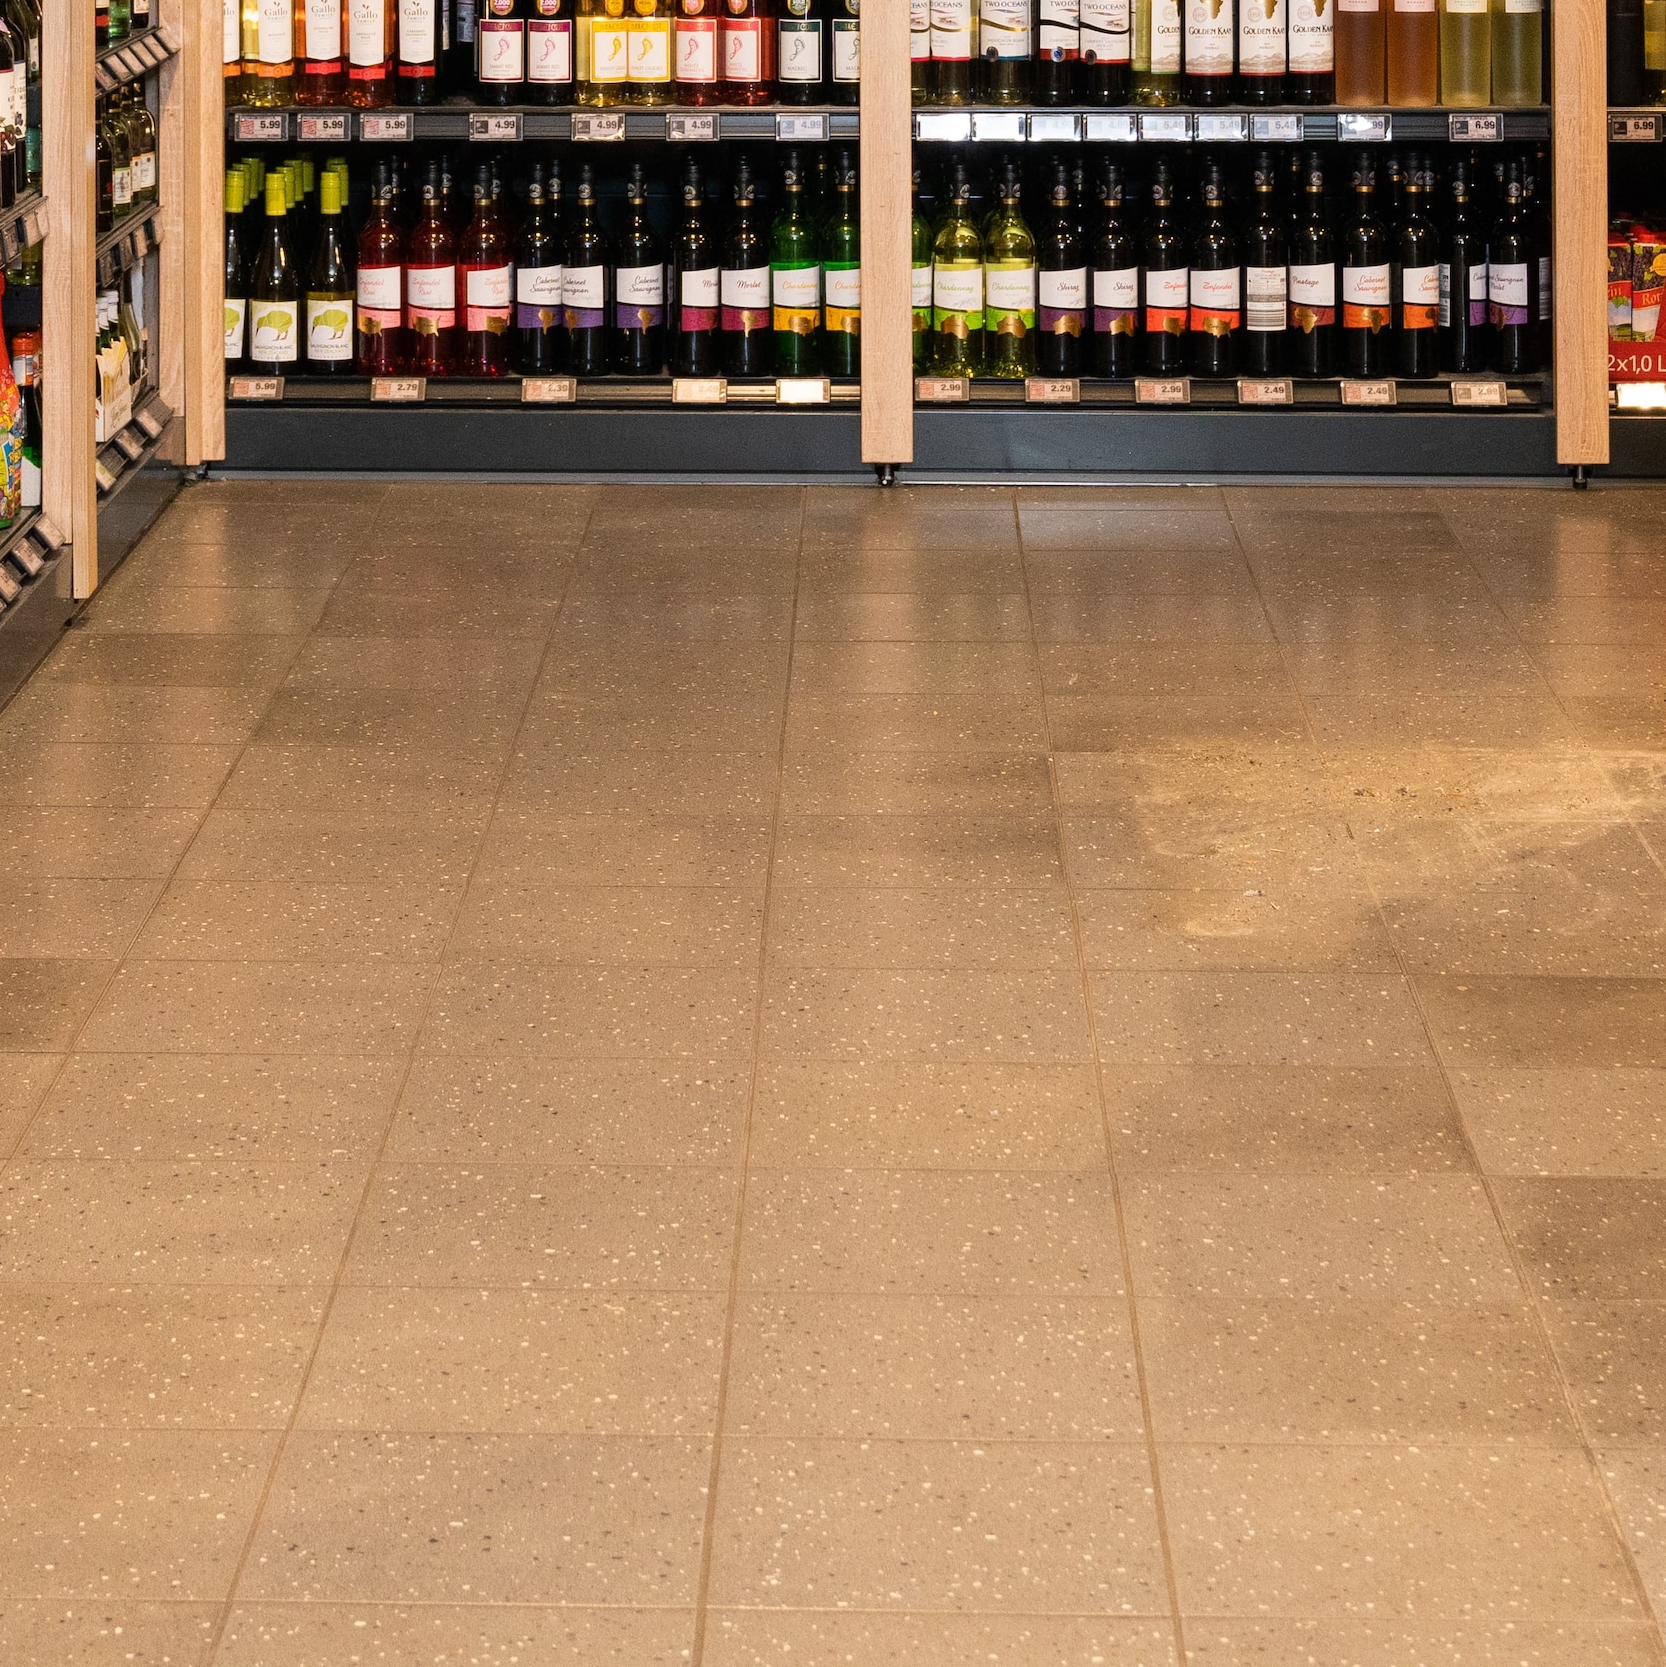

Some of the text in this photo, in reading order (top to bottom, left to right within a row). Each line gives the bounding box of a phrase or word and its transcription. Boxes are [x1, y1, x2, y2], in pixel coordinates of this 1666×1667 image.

[984, 0, 1028, 8] TWO OCEANS
[264, 8, 288, 17] Gallo
[311, 5, 335, 14] Gallo
[404, 7, 428, 16] Gallo
[353, 10, 378, 19] Gallo
[1189, 26, 1215, 35] GOLDEN
[1243, 26, 1271, 35] GOLDEN
[260, 120, 281, 129] 5.99
[322, 120, 343, 129] 5.99
[385, 120, 405, 129] 5.99
[495, 120, 515, 129] 4.99
[597, 120, 617, 129] 4.99
[691, 120, 712, 129] 4.99
[1475, 120, 1495, 129] 6.99
[634, 276, 659, 285] Cabernet
[736, 279, 761, 289] Merlot
[1292, 275, 1319, 287] Pinotage
[1359, 275, 1386, 285] Cabernet
[1056, 283, 1080, 293] Shiraz
[255, 382, 275, 391] 5.99
[397, 383, 418, 392] 2.79
[941, 383, 961, 392] 2.99
[1051, 384, 1071, 393] 2.29
[1161, 385, 1181, 393] 2.99
[1264, 385, 1284, 394] 2.49
[1367, 386, 1387, 395] 2.49
